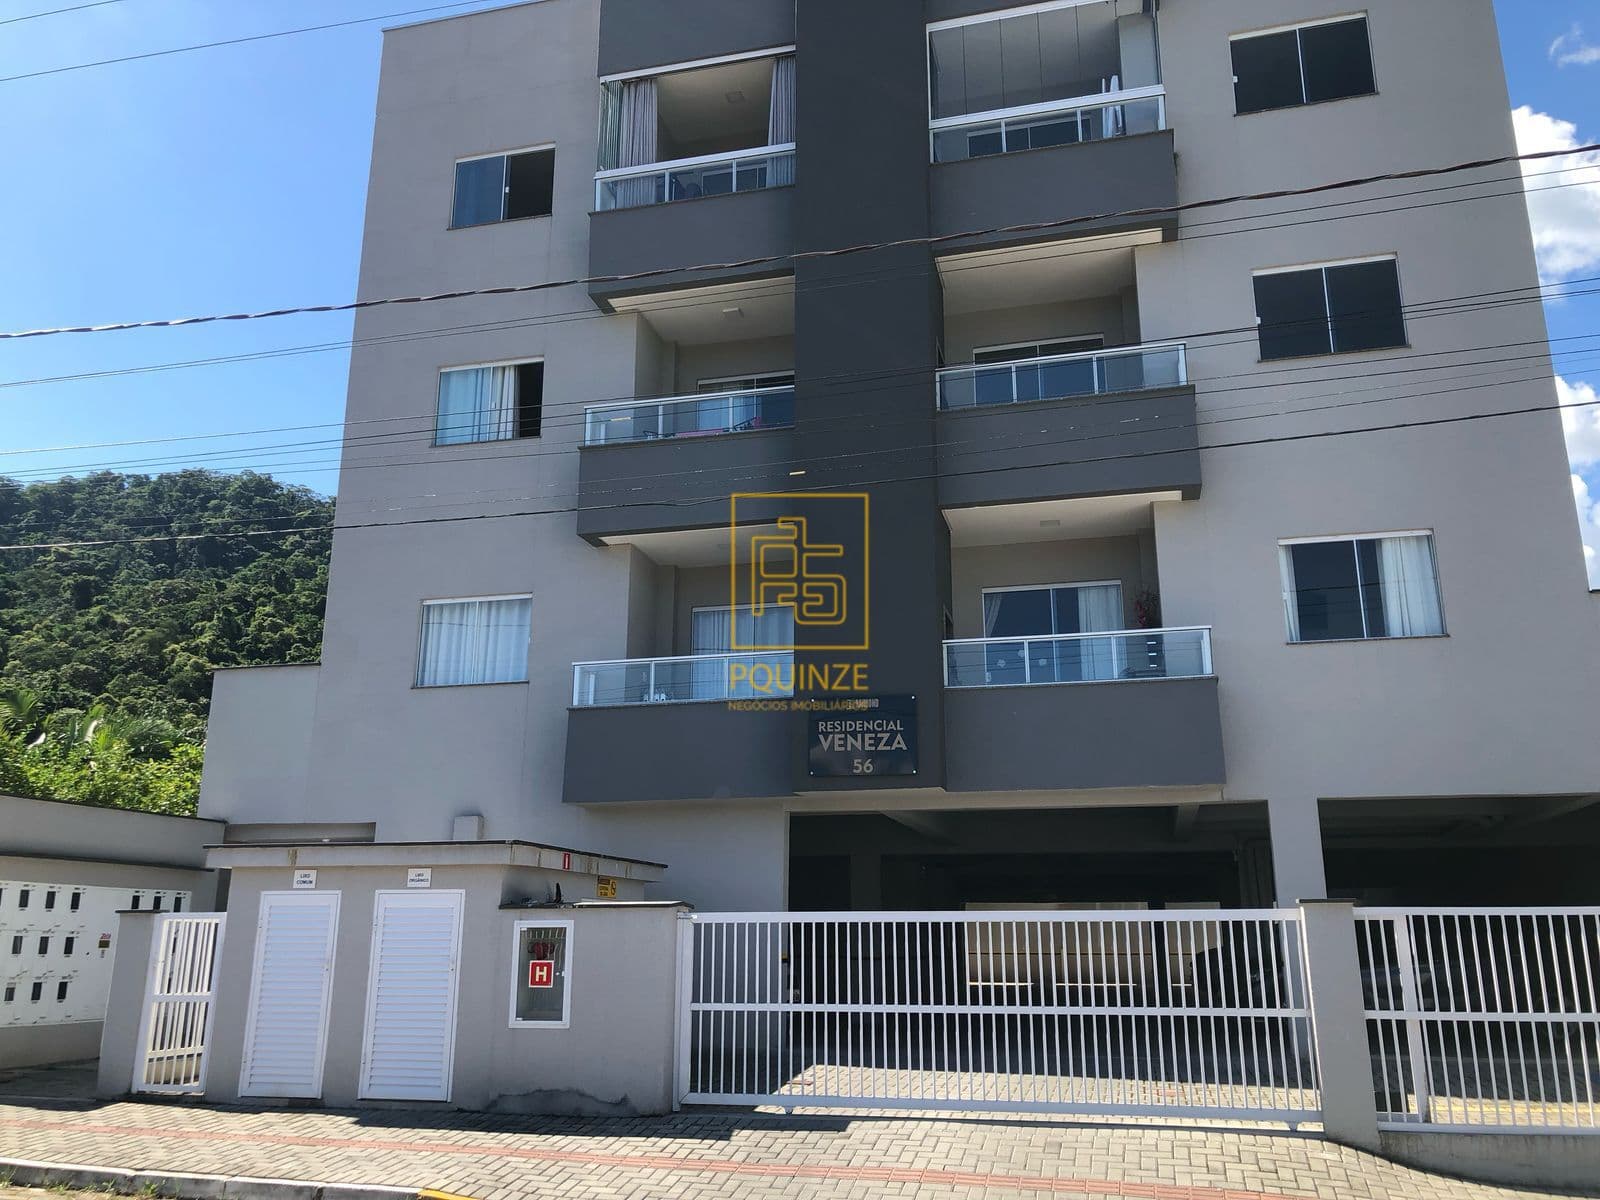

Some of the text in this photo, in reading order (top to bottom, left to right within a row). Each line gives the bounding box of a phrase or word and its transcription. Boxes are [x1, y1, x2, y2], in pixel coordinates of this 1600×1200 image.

[818, 719, 904, 732] RESIDENCIAL
[818, 733, 908, 752] VENEZA
[852, 759, 874, 774] 56
[535, 966, 547, 982] H
